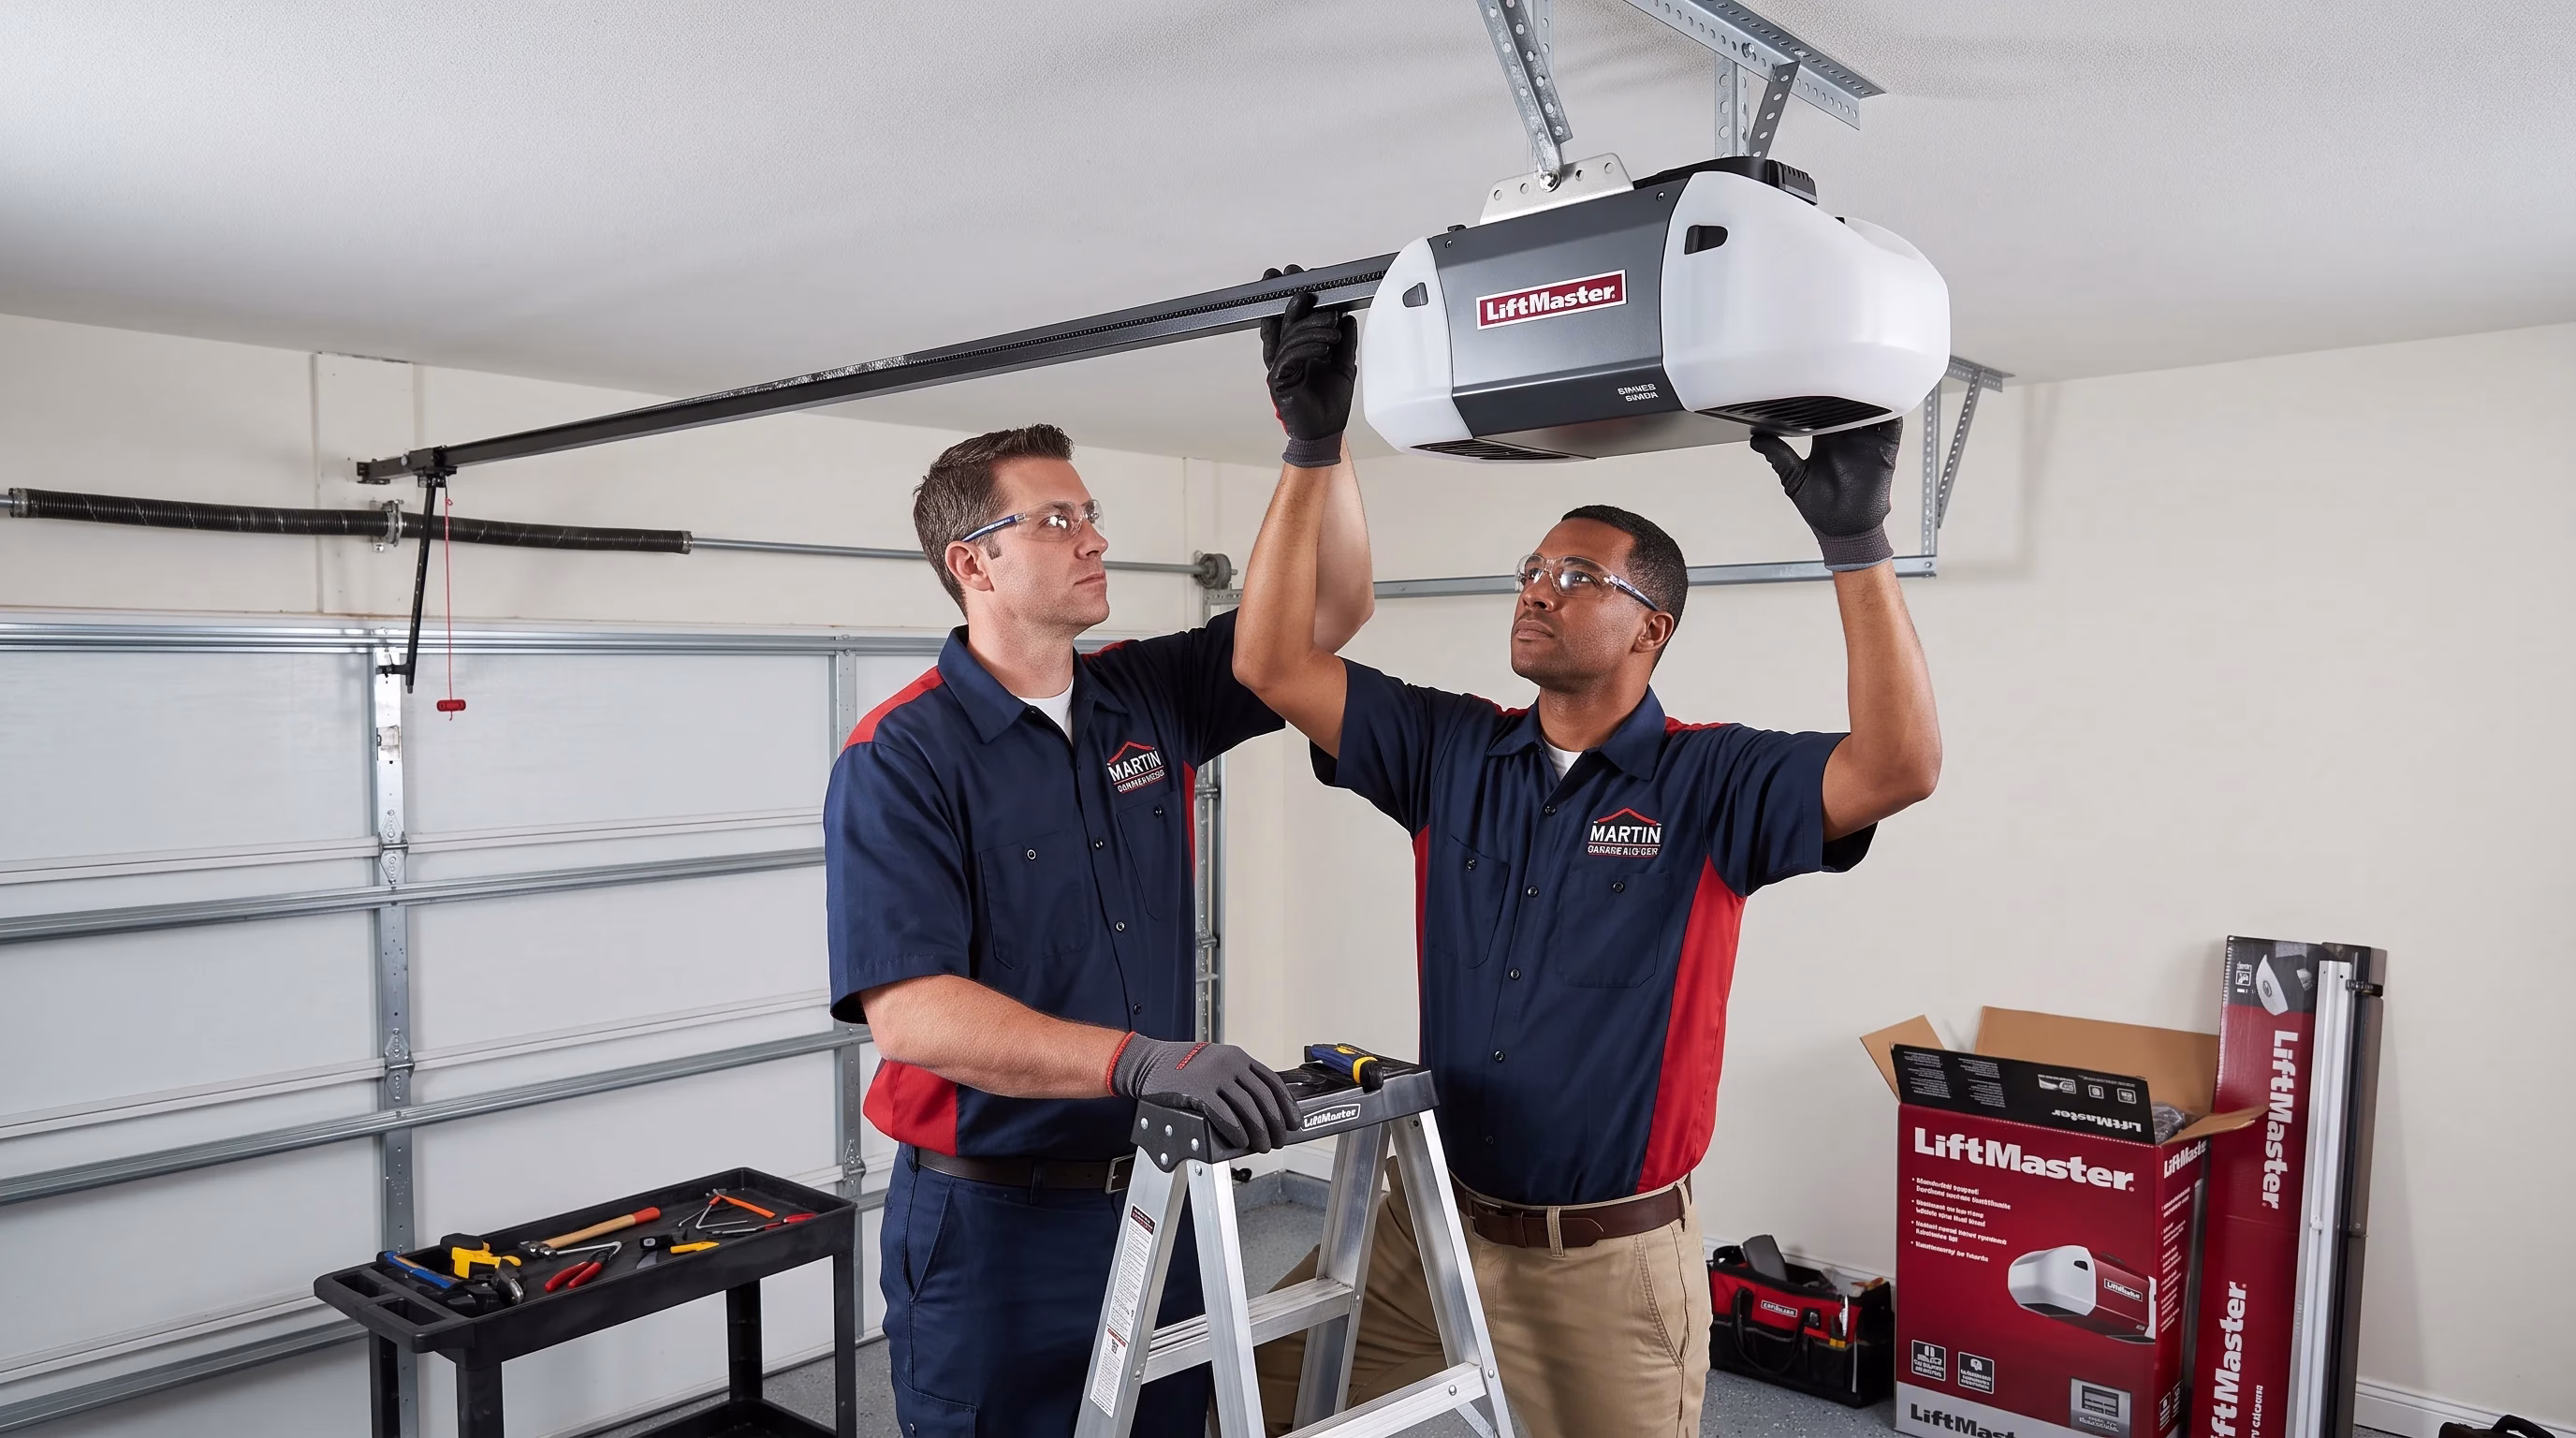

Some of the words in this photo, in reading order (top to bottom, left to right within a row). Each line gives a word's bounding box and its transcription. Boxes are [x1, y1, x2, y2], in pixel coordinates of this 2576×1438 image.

[1486, 284, 1616, 321] LiftMaster
[1107, 750, 1162, 783] MARTIN
[1589, 825, 1661, 844] MARTIN
[2261, 1029, 2299, 1211] LiftMaster
[1914, 1126, 2135, 1191] LiftMaster
[2209, 1281, 2247, 1438] ftMaster
